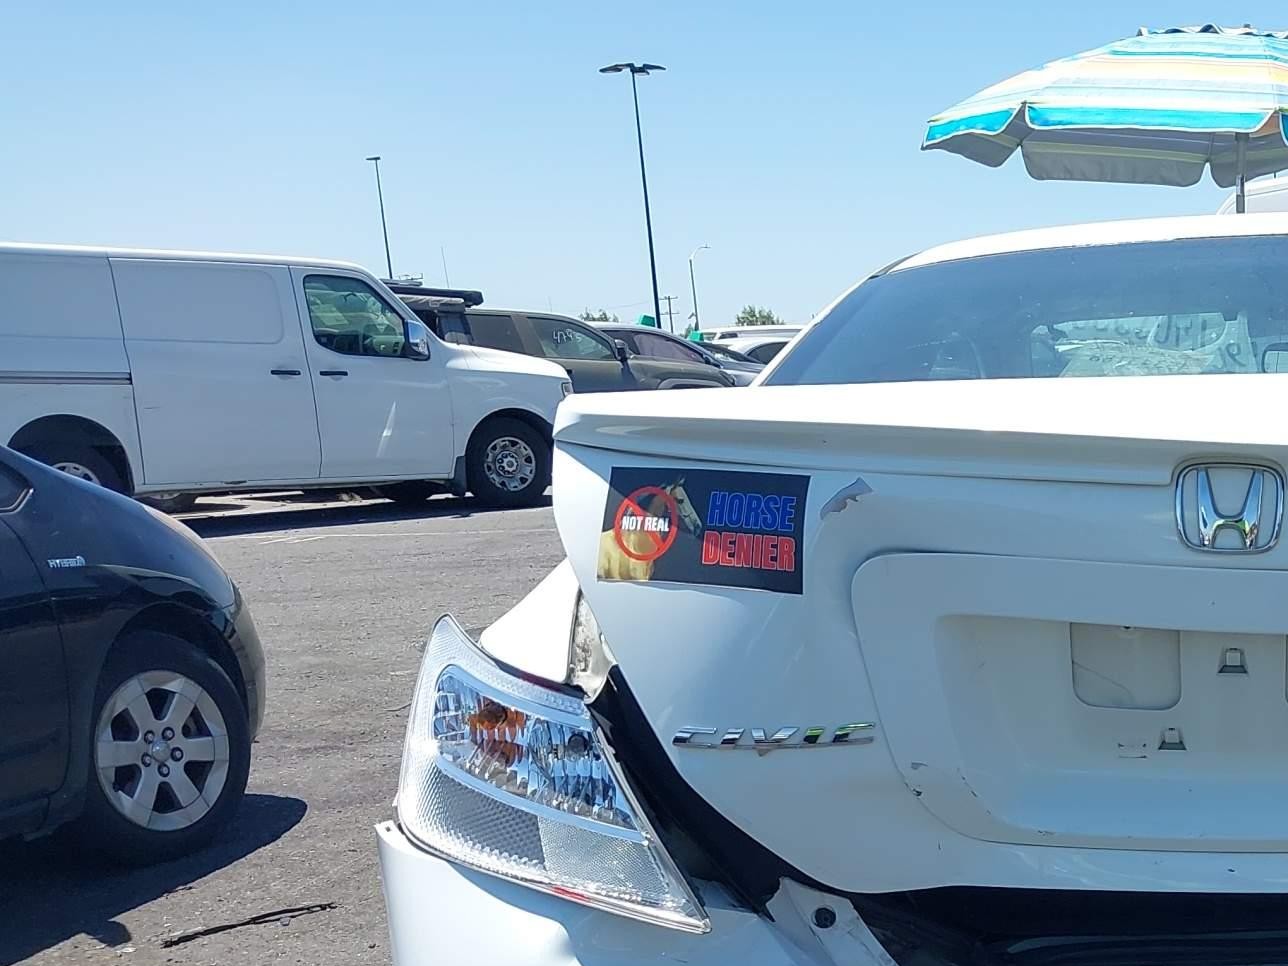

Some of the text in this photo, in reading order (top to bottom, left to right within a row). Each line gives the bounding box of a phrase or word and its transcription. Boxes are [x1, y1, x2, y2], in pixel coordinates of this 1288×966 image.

[621, 515, 671, 532] NOT REAL
[708, 491, 796, 532] HORSE
[702, 531, 795, 572] DENIER
